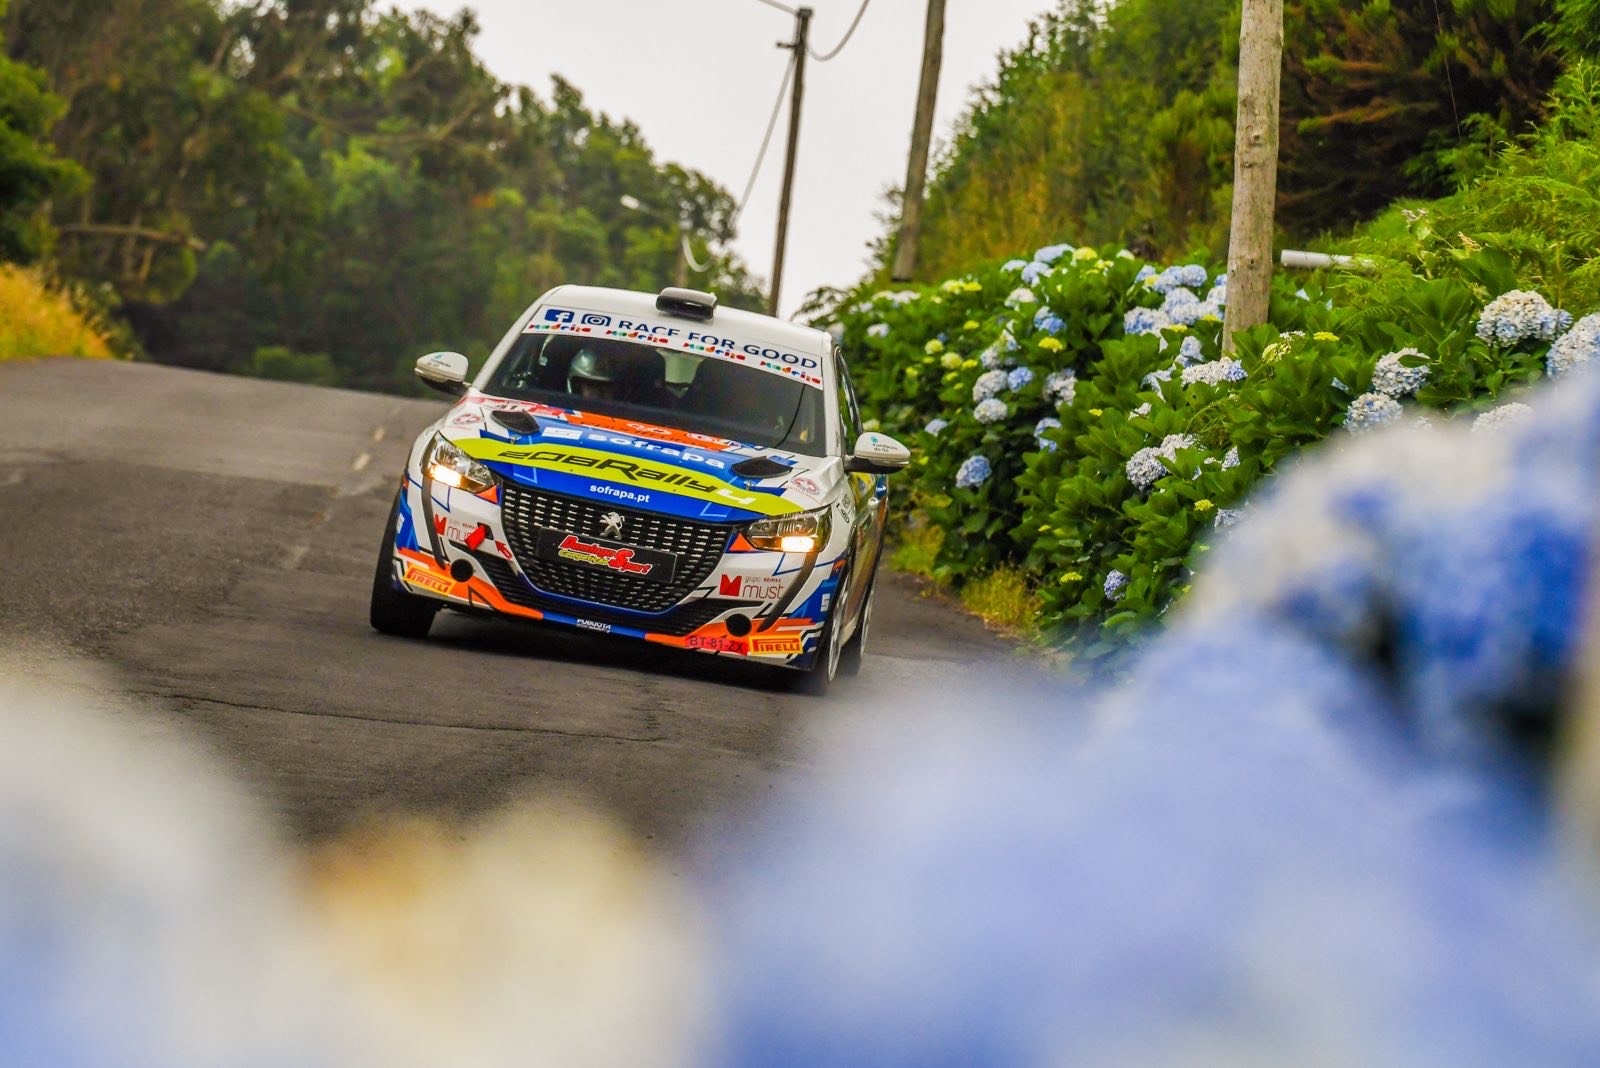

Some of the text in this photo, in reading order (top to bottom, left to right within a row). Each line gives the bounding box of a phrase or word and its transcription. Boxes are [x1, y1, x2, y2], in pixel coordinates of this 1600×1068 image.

[688, 332, 736, 350] FOR
[743, 344, 818, 369] GOOD
[587, 433, 725, 470] sofrapa
[589, 484, 650, 503] sofrapa.pt
[407, 568, 453, 593] PIRELLI
[742, 584, 784, 600] must
[751, 638, 800, 652] PIRELLI
